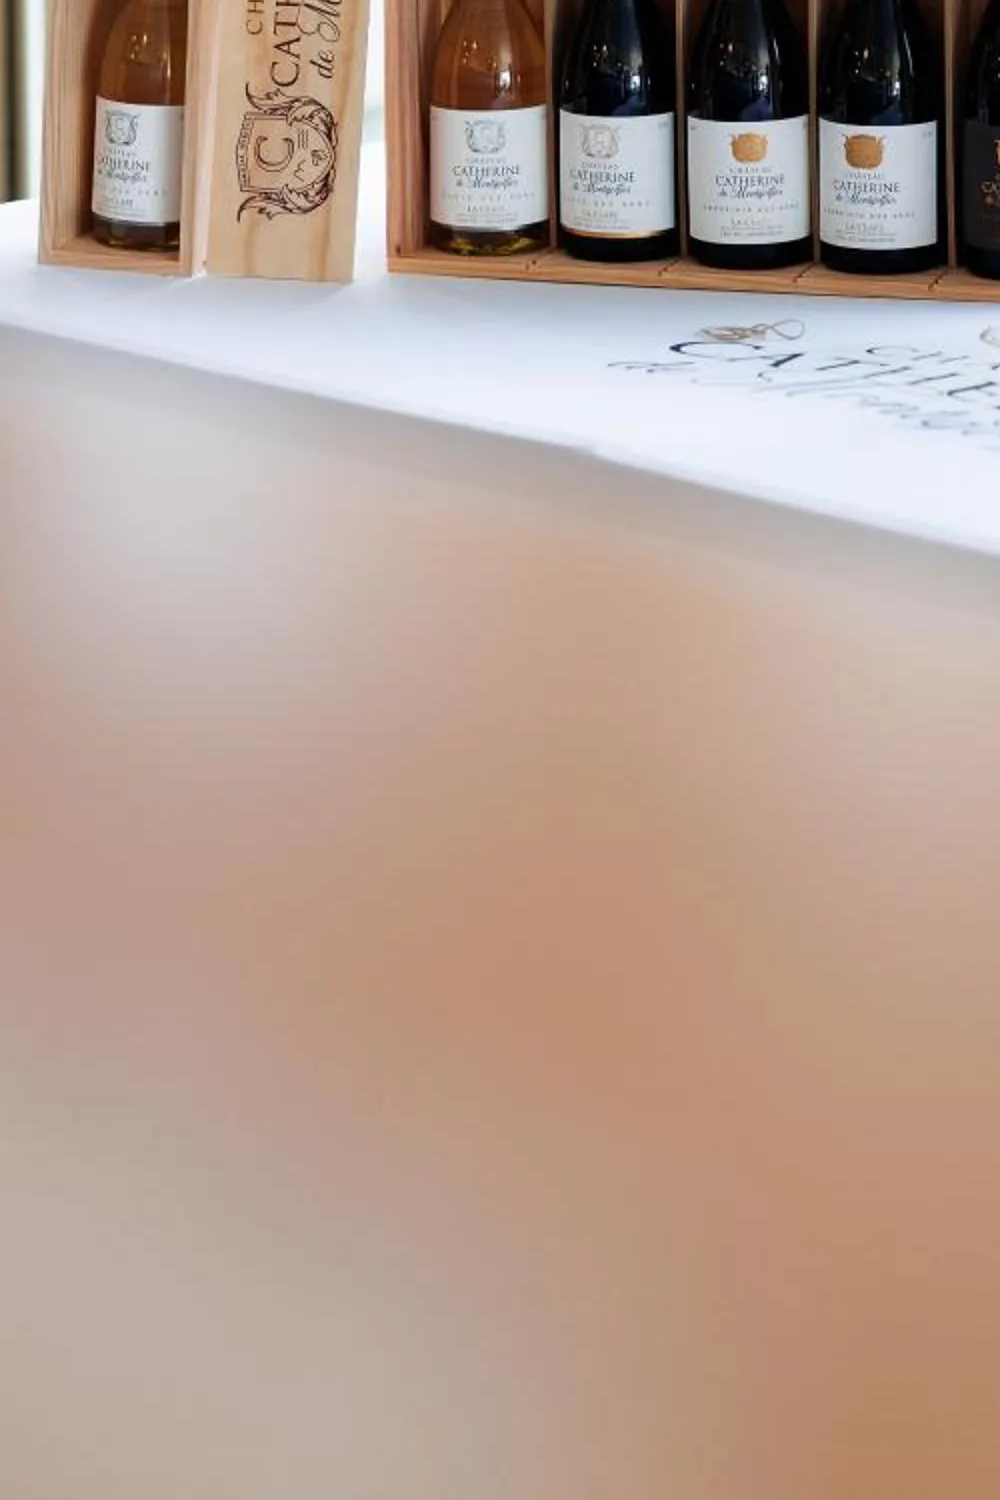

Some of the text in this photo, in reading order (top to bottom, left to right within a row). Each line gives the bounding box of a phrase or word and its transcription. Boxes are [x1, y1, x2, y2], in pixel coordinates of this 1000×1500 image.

[309, 50, 335, 80] de
[569, 169, 637, 184] CATHERINE
[715, 174, 785, 188] CATHERINE
[833, 180, 901, 194] CATHERINE
